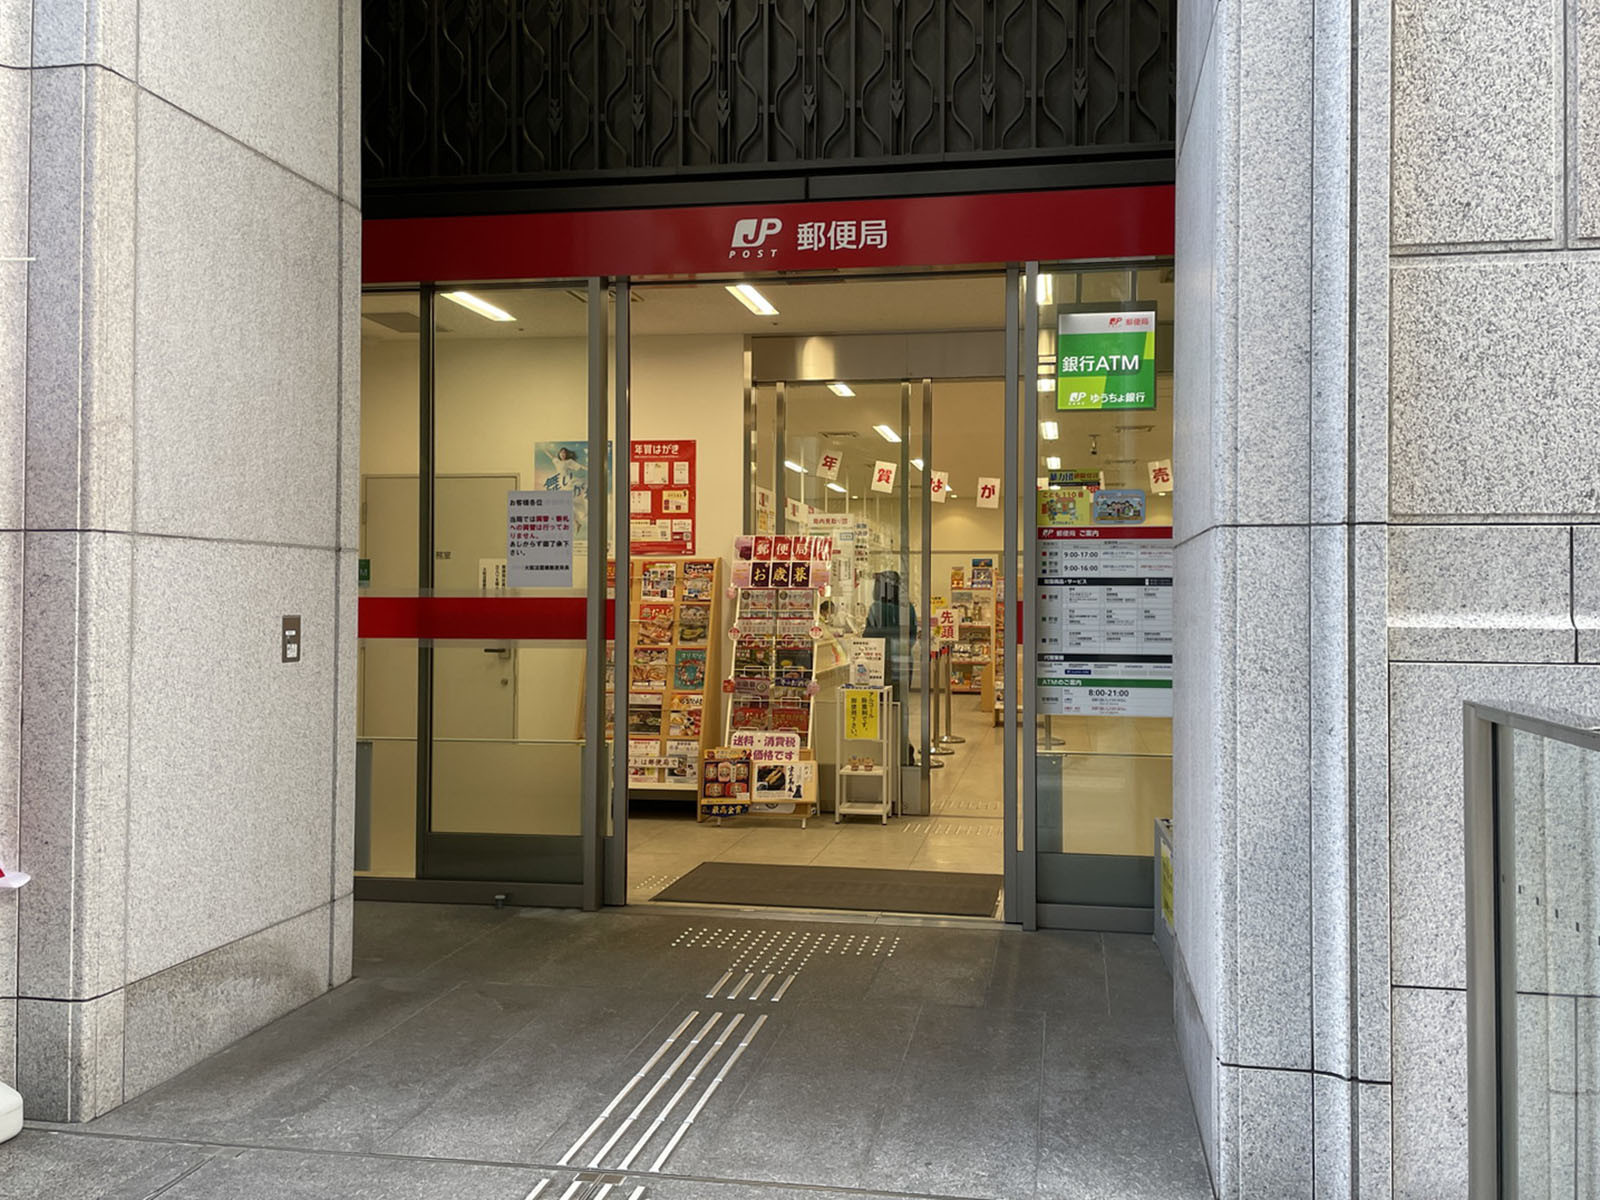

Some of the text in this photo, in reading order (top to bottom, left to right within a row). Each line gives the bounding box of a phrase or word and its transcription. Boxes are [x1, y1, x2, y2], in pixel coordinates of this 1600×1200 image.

[797, 220, 888, 251] 郵便局
[728, 249, 778, 259] POST
[1062, 354, 1139, 372] 銀行ATM
[1090, 392, 1145, 403] ゆうちょ銀行
[634, 443, 680, 455] 年賀はがき
[821, 454, 838, 471] 年
[876, 468, 893, 485] 賀
[980, 484, 996, 499] が
[1152, 467, 1170, 483] 売
[754, 567, 807, 582] お歳暮
[940, 610, 955, 639] 先頭
[1088, 689, 1129, 697] 8:00-21:00
[733, 735, 796, 747] 送料・消費税
